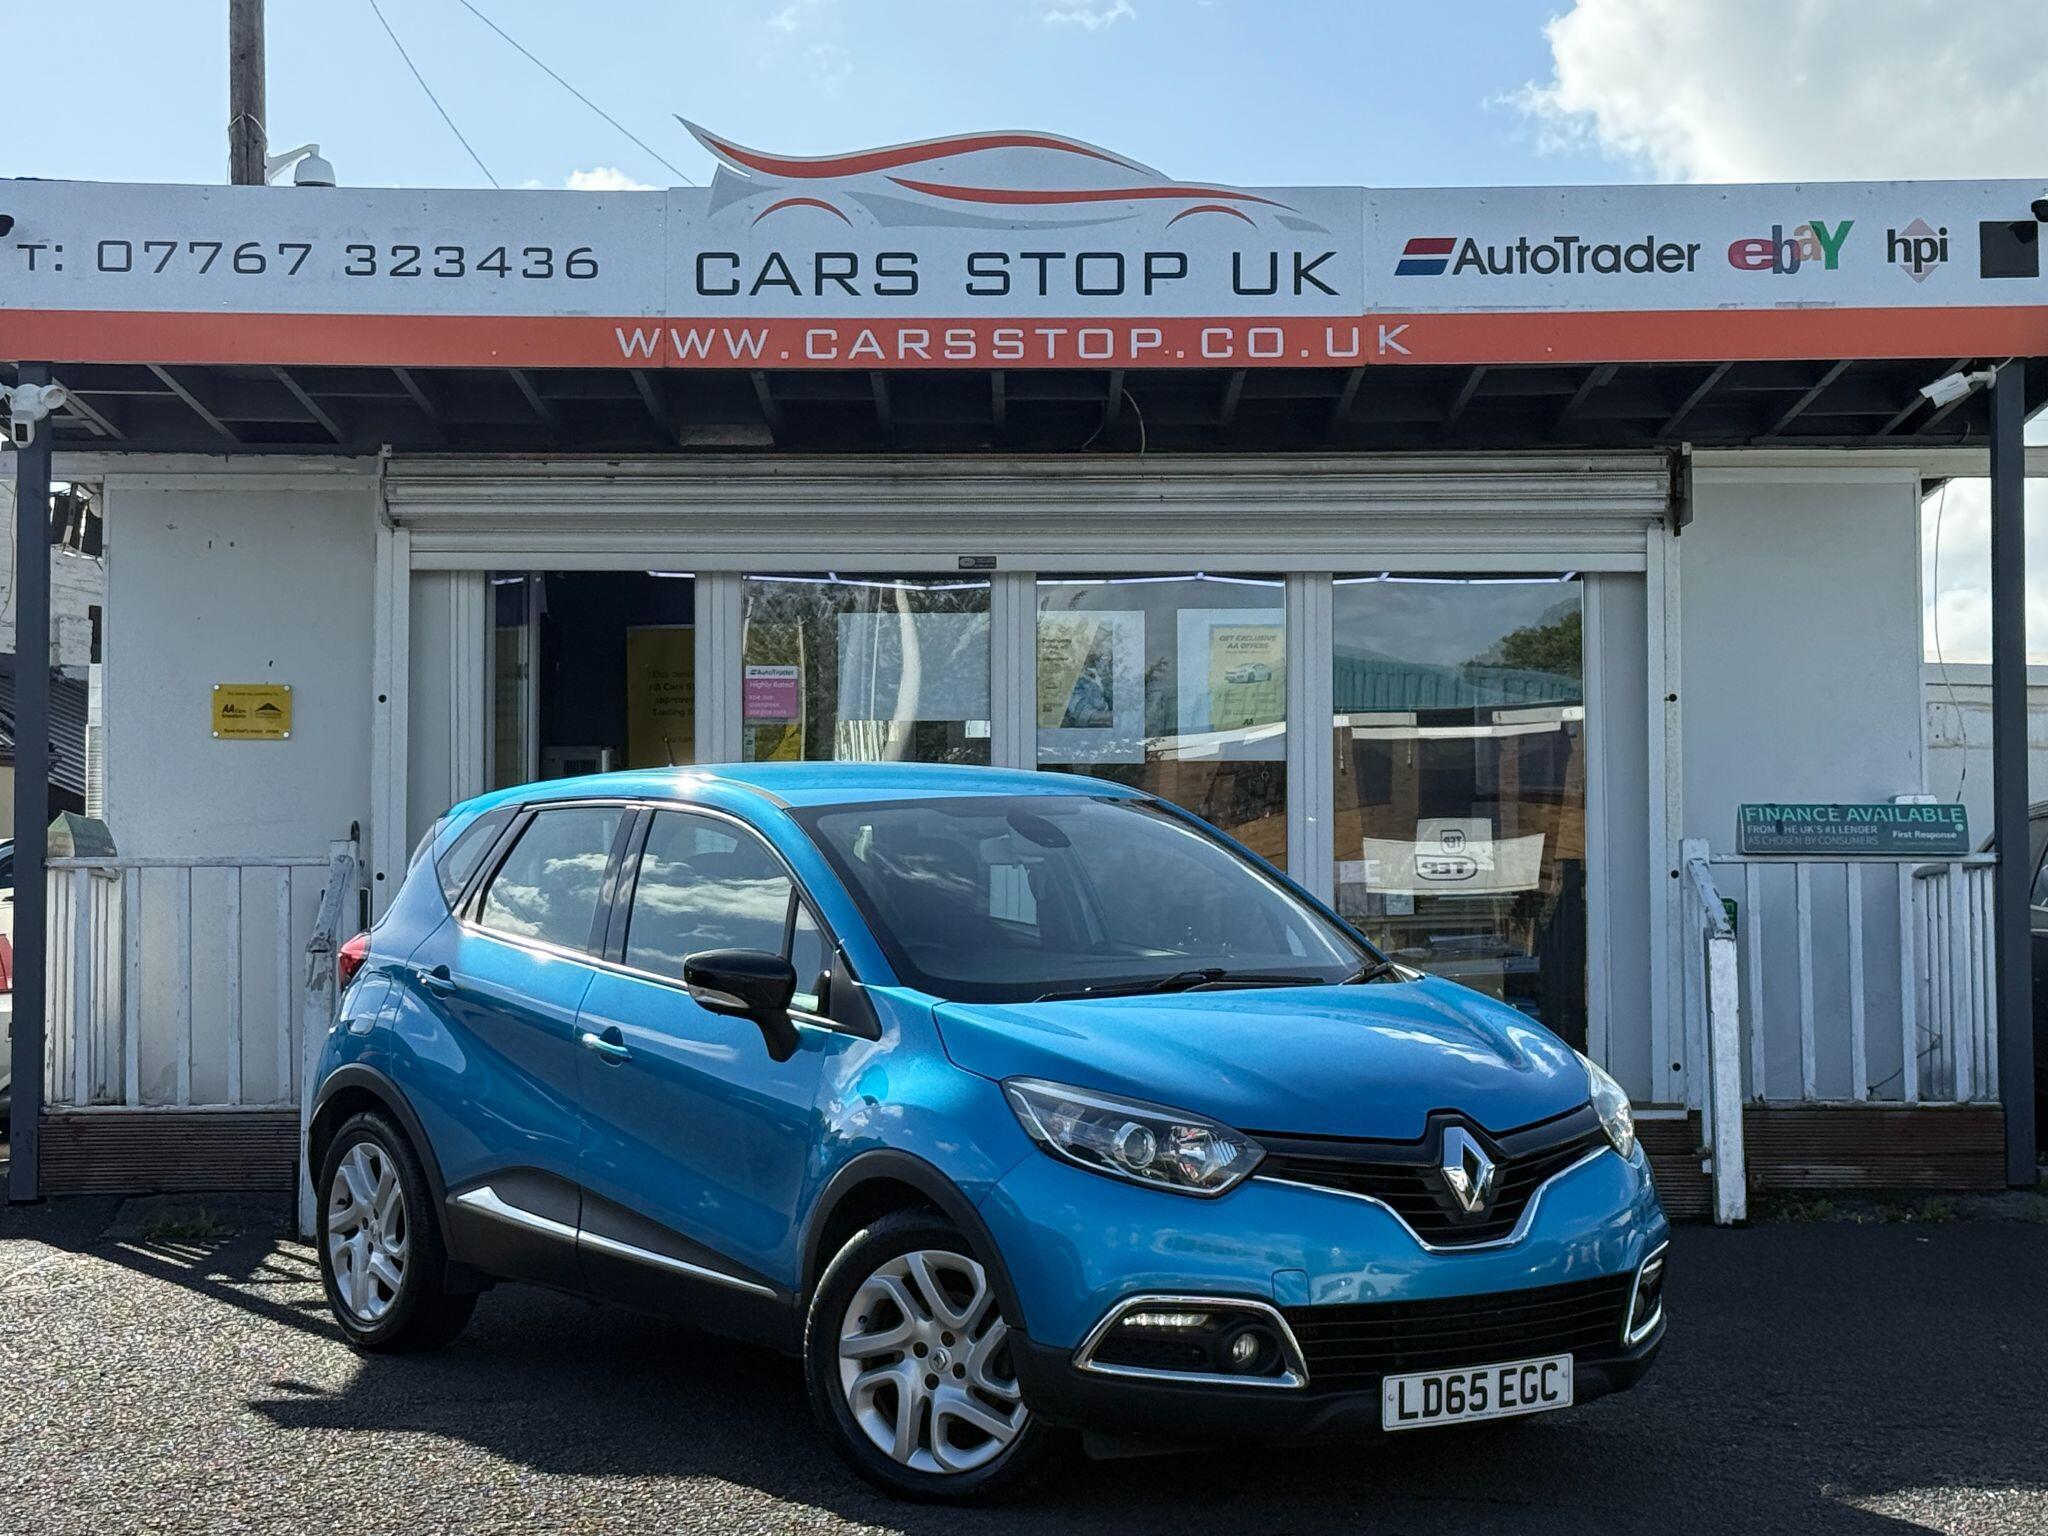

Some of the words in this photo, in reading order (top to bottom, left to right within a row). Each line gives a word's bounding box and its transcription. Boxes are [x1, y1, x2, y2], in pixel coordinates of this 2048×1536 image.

[16, 243, 63, 272] T:
[97, 239, 312, 276] 07767
[344, 244, 600, 280] 323436
[1452, 235, 1701, 276] AutoTrader
[1886, 227, 1949, 273] hpi
[695, 252, 920, 297] CARS
[965, 252, 1189, 297] STOP
[1231, 252, 1342, 297] UK
[614, 323, 1413, 361] WWW.CARSSTOP.CO.UK
[1745, 807, 1841, 822] FINANCE
[1846, 807, 1963, 822] AVAILABLE
[1747, 825, 1776, 834] FROM
[1777, 825, 1798, 834] HE
[1800, 825, 1824, 834] UK'S
[1825, 825, 1836, 834] #1
[1838, 825, 1878, 834] LENDER
[1892, 831, 1912, 839] First
[1914, 831, 1958, 840] Response
[1398, 1371, 1488, 1421] LD65
[1499, 1362, 1559, 1408] EGC
